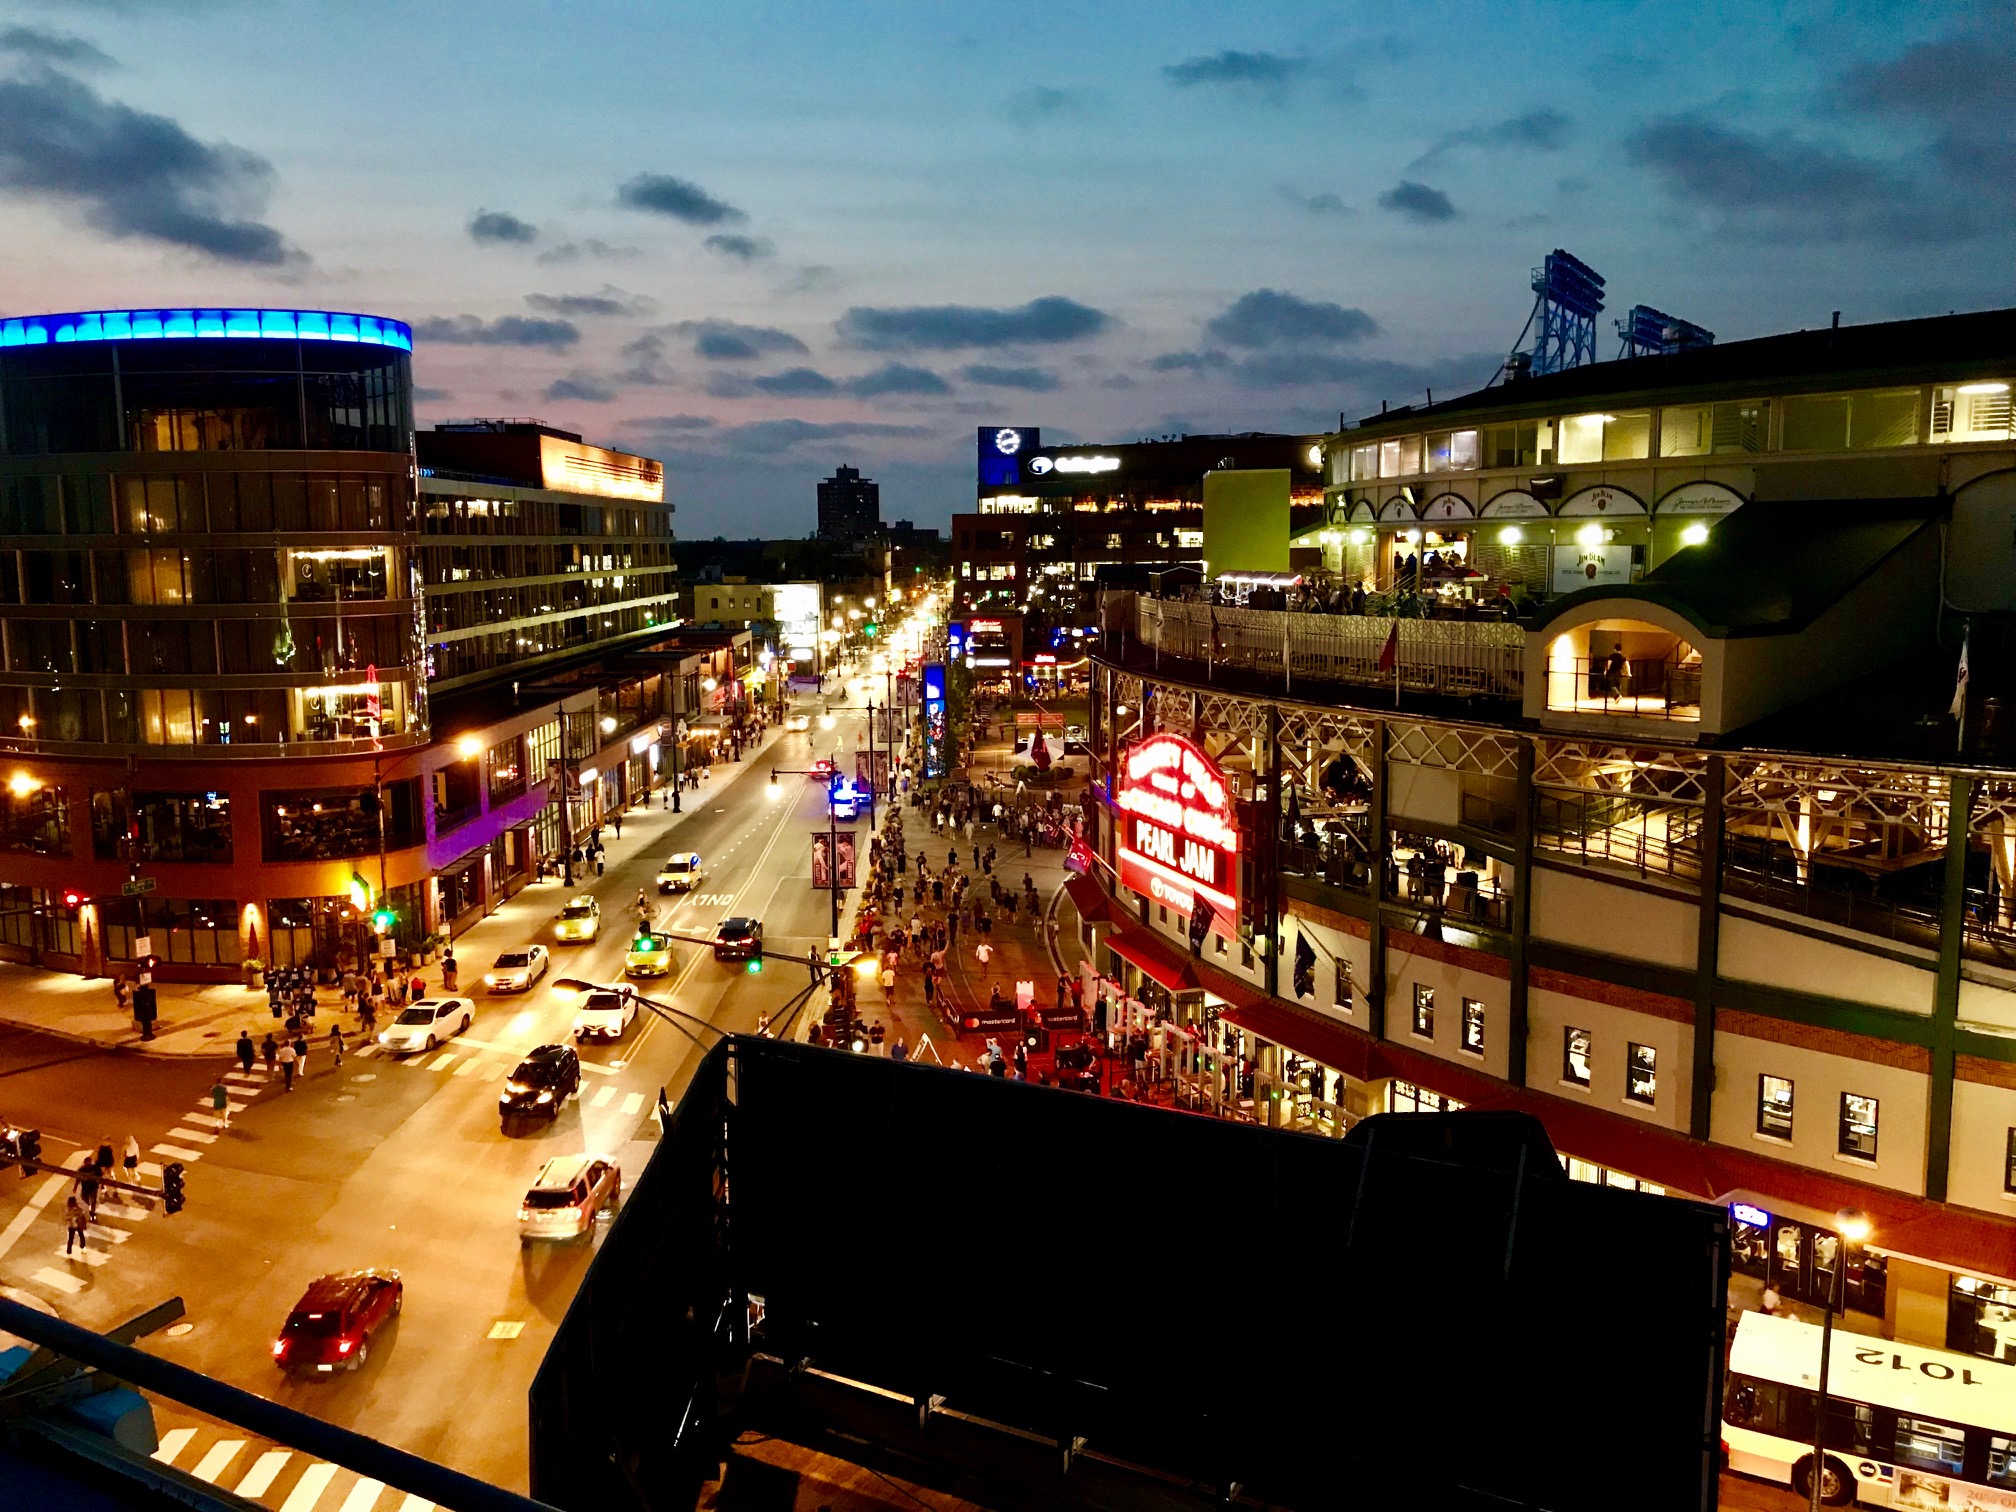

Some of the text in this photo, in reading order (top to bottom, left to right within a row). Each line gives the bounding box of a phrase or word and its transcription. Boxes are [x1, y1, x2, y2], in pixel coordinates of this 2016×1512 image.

[1136, 819, 1177, 867] PEARL
[1179, 838, 1215, 884] JAM
[684, 893, 735, 907] ONLY
[981, 1017, 1016, 1025] mastercard
[1855, 1347, 1982, 1385] 1012
